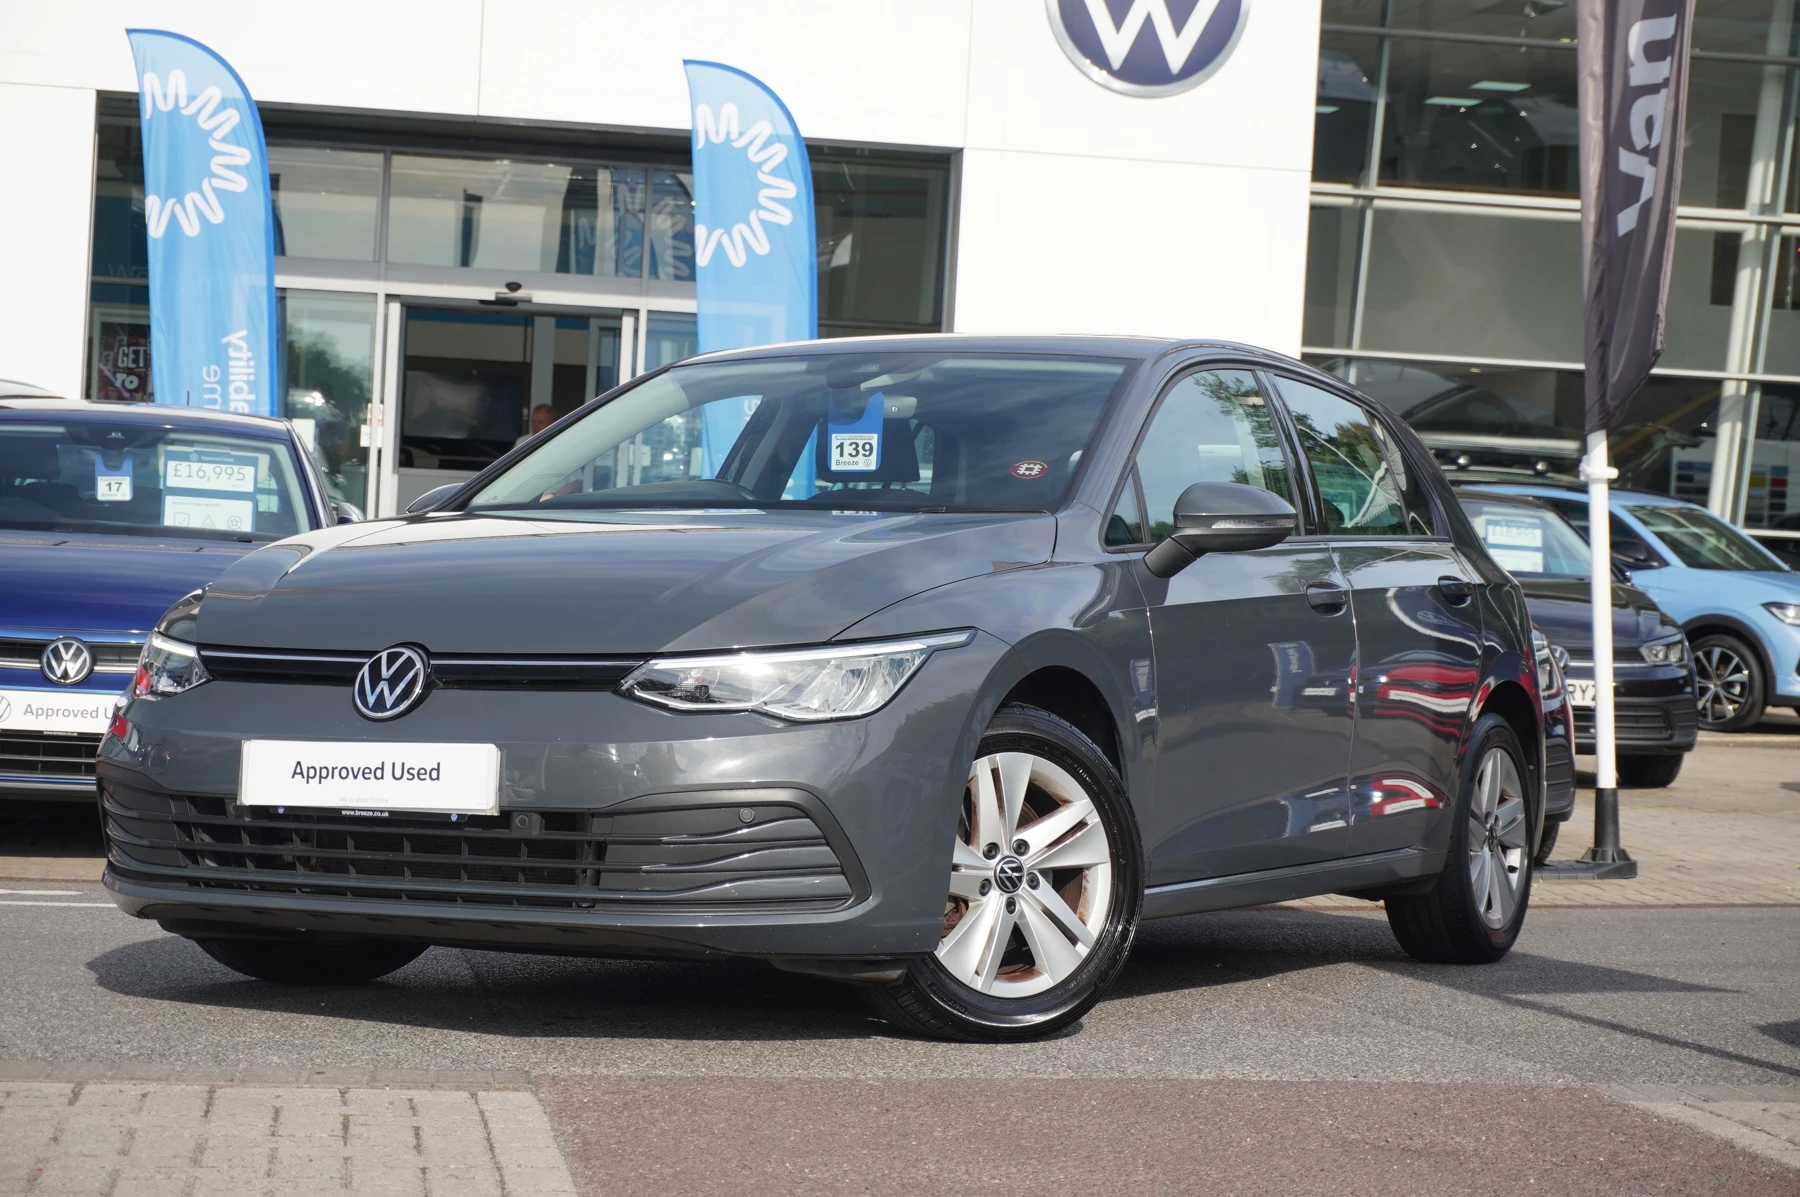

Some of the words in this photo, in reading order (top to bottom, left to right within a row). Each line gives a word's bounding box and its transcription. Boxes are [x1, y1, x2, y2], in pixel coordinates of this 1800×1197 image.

[1617, 13, 1677, 237] Van
[118, 346, 147, 369] GET
[115, 372, 139, 390] TO
[835, 441, 874, 458] 139
[173, 463, 246, 482] £16,995
[105, 481, 123, 492] 17
[23, 703, 99, 720] Approved
[291, 760, 385, 784] Approved
[391, 761, 441, 782] Used
[341, 809, 390, 817] www.breeze.co.uk
